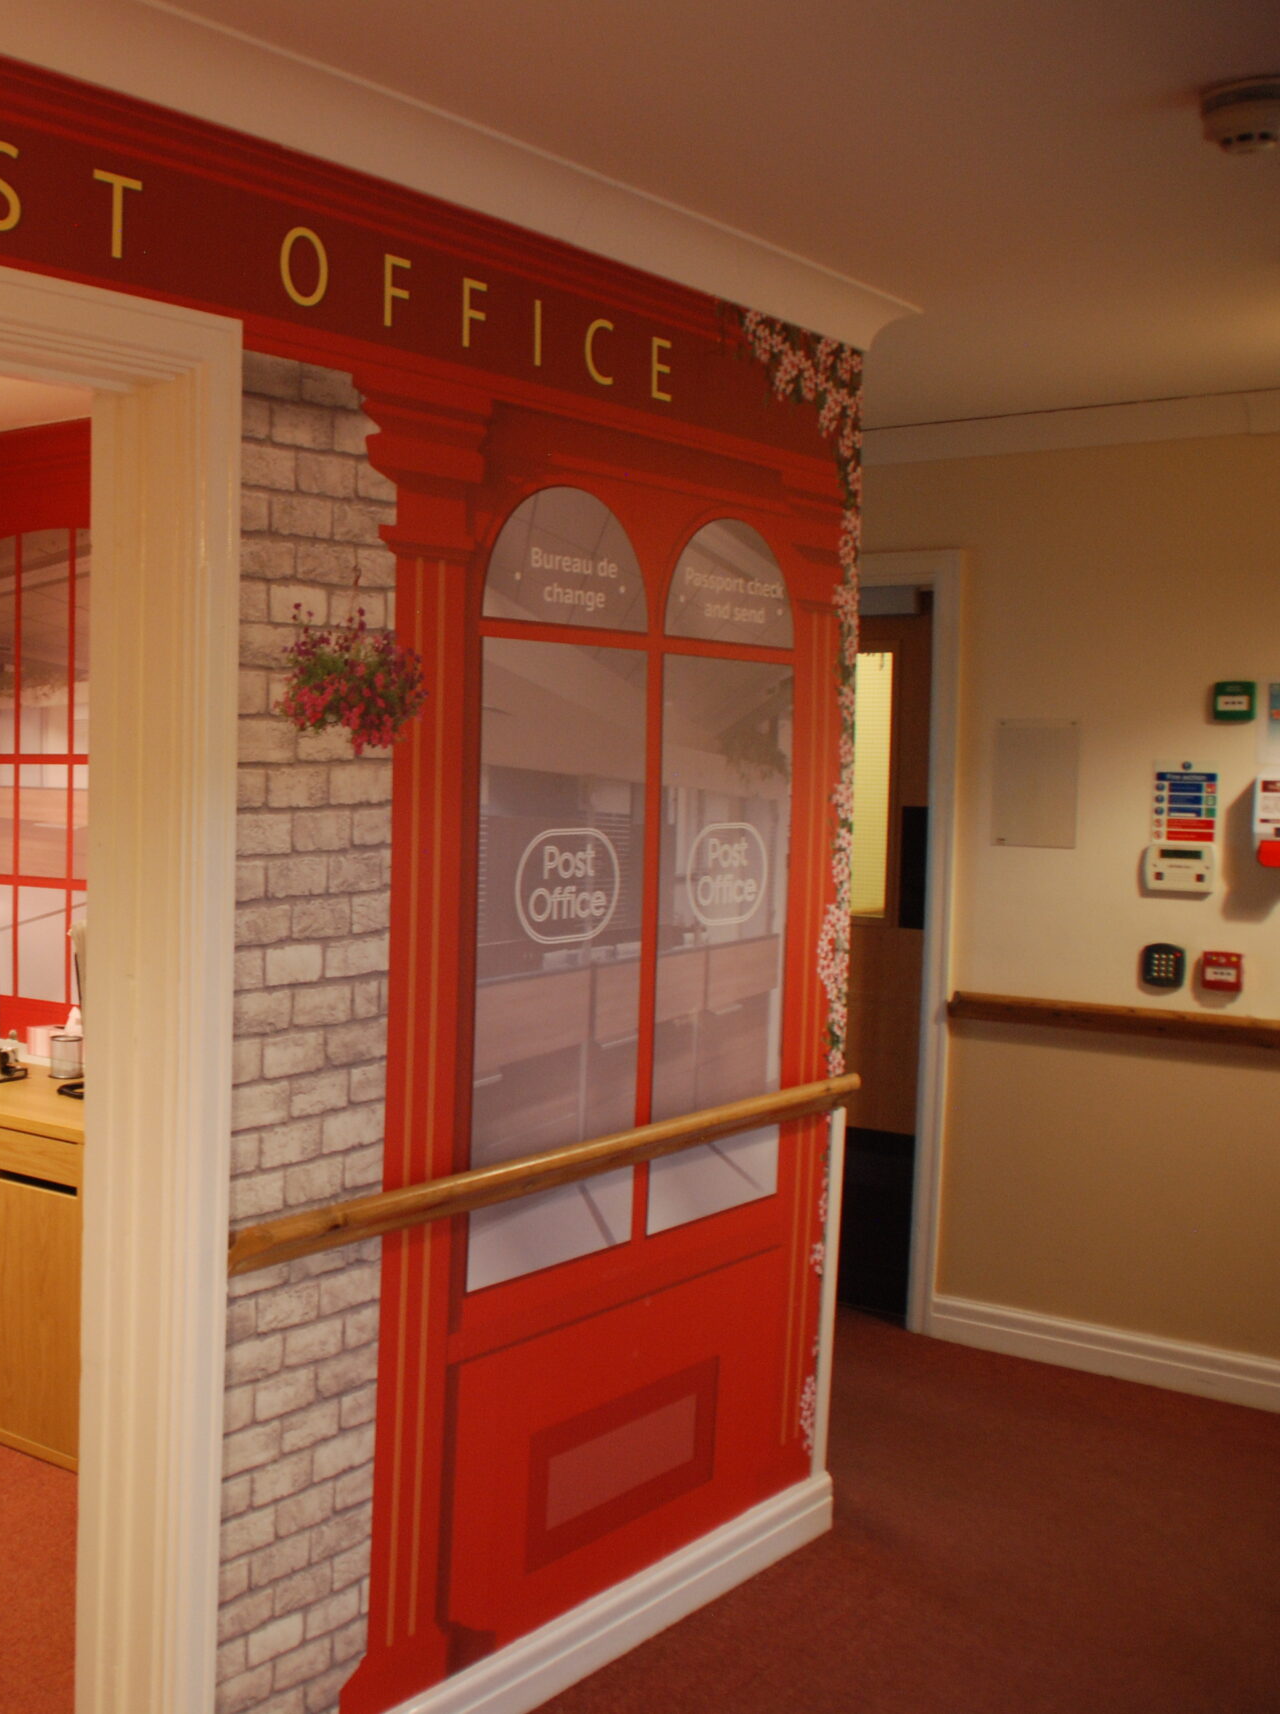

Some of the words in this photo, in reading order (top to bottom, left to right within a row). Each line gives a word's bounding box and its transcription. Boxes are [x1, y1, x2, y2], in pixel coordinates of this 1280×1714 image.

[279, 226, 673, 402] OFFICE
[530, 546, 593, 575] Bureau
[598, 557, 618, 579] de
[543, 582, 606, 610] change
[685, 567, 744, 593] Passport
[747, 578, 785, 599] check
[704, 602, 730, 619] and
[733, 607, 765, 624] send
[543, 844, 595, 879] Post
[708, 837, 748, 867] Post
[528, 885, 607, 923] Office
[697, 874, 758, 906] Office
